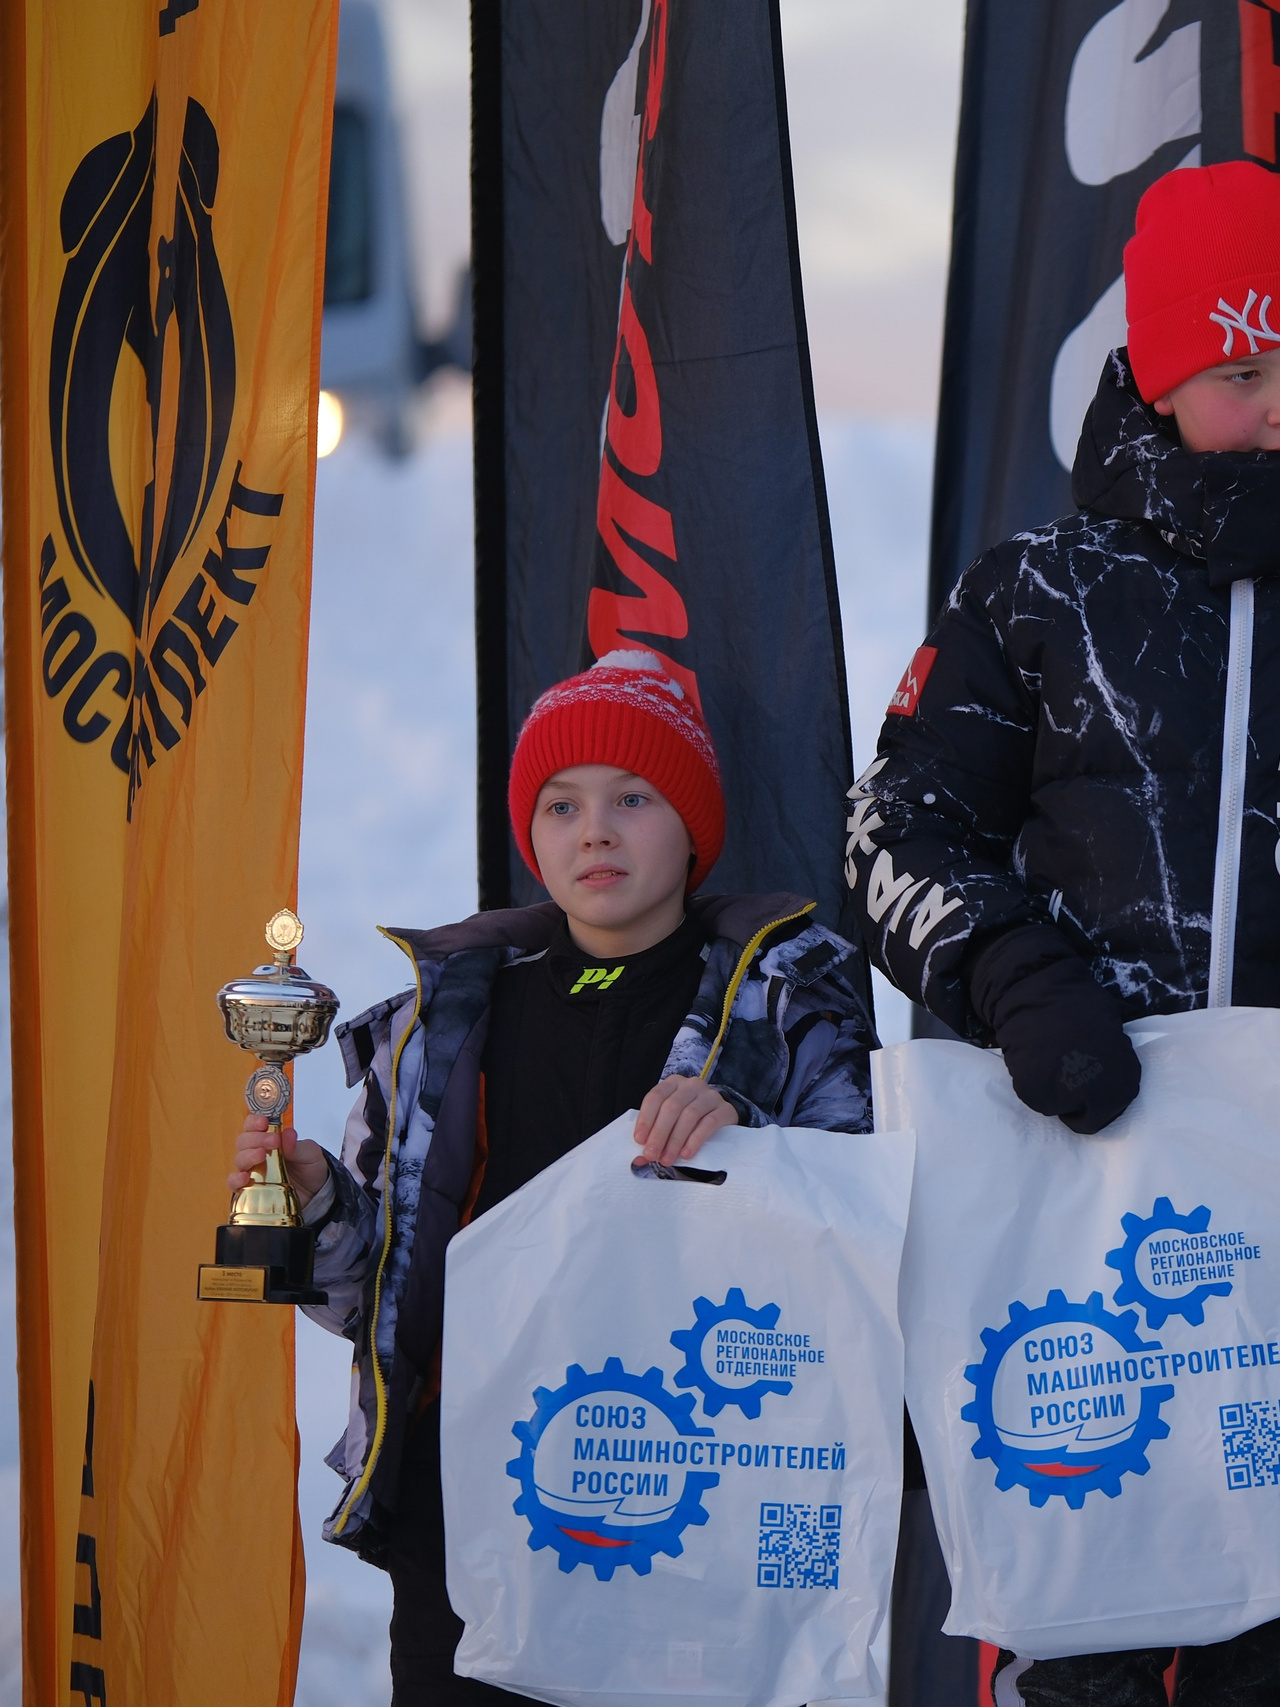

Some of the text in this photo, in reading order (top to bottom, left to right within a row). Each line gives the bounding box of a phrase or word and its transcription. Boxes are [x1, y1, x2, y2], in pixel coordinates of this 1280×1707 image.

[1148, 1231, 1245, 1255] МОСКОВСКОЕ
[1151, 1245, 1261, 1271] РЕГИОНАЛЬНОЕ
[1152, 1264, 1235, 1287] ОТДЕЛЕНИЕ
[716, 1329, 810, 1347] МОСКОВСКОЕ
[1024, 1332, 1094, 1363] СОЮЗ
[716, 1345, 825, 1363] РЕГИОНАЛЬНОЕ
[716, 1361, 797, 1378] ОТДЕЛЕНИЕ
[576, 1404, 647, 1430] СОЮЗ
[1030, 1393, 1126, 1429] РОССИИ
[573, 1437, 846, 1471] МАШИНОСТРОИТЕЛЕЙ
[572, 1471, 669, 1497] РОССИИ
